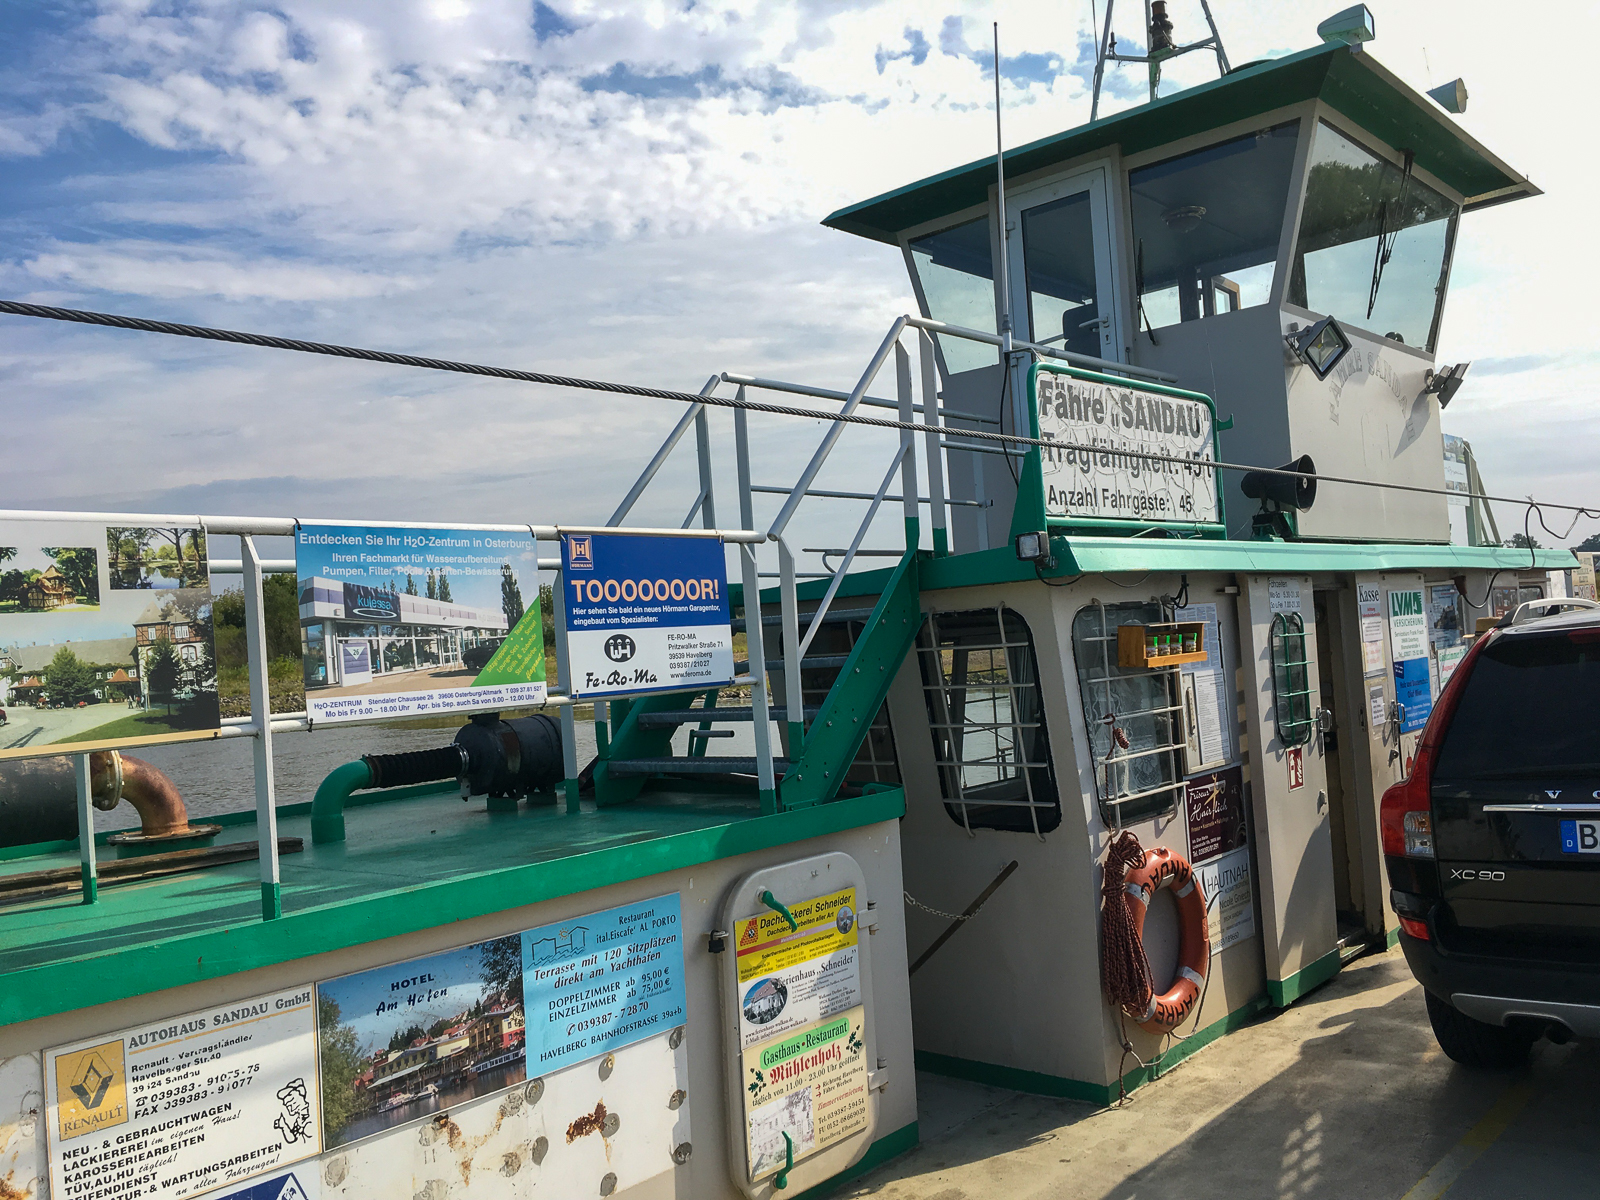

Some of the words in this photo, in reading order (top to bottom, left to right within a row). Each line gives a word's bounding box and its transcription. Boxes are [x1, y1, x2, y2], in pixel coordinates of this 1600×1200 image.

[1040, 380, 1105, 425] Fähre
[1048, 485, 1097, 508] Anzahl
[1102, 489, 1170, 515] Fahrgäste:
[1180, 494, 1192, 513] 45
[300, 533, 362, 545] Entdecken
[366, 534, 383, 546] Sie
[386, 536, 401, 546] Ihr
[473, 538, 482, 547] in
[484, 538, 534, 550] Osterburg,
[576, 544, 585, 555] H
[332, 553, 358, 563] Ihren
[360, 554, 409, 563] Fachmarkt
[411, 554, 424, 563] für
[426, 554, 510, 565] Wasseraufbereitung,
[322, 566, 366, 577] Pumpen,
[368, 566, 395, 577] Filter,
[398, 566, 424, 576] Pools
[434, 567, 519, 578] Garten-Bewässerung
[571, 579, 719, 603] TOOOOOOOR!
[1359, 586, 1380, 603] Kasse
[358, 595, 392, 610] kulessa
[608, 606, 618, 614] Sie
[690, 604, 720, 613] Garagentor,
[1391, 592, 1413, 617] LVM
[574, 618, 605, 626] eingebaut
[621, 616, 658, 624] Spezialisten:
[1394, 618, 1424, 628] VERSICHERUNG
[486, 644, 509, 673] Sitzgruppen
[670, 670, 712, 678] www.feroma.de
[368, 698, 397, 706] Stendaler
[438, 692, 454, 700] 39606
[454, 689, 502, 698] Osterburg/Altmark
[1567, 840, 1573, 848] D
[1208, 863, 1248, 894] HAUTNAH
[816, 894, 852, 913] Schneider
[619, 909, 655, 925] Restaurant
[640, 922, 649, 932] AL
[652, 914, 677, 929] PORTO
[816, 914, 826, 923] aller
[534, 962, 576, 981] Terrasse
[582, 954, 598, 968] mit
[604, 948, 622, 961] 120
[627, 934, 677, 956] Sitzplätzen
[554, 974, 583, 989] direkt
[590, 968, 604, 979] am
[610, 951, 661, 973] Yachthafen
[391, 974, 435, 991] HOTEL
[549, 982, 621, 1011] DOPPELZIMMER
[626, 977, 636, 987] ab
[642, 969, 663, 983] 95,00
[376, 1001, 398, 1016] Am
[408, 988, 448, 1006] Hafen
[550, 994, 617, 1022] EINZELZIMMER
[626, 989, 637, 999] ab
[642, 980, 664, 994] 75,00
[129, 1019, 206, 1049] AUTOHAUS
[213, 1002, 269, 1026] SANDAU
[275, 992, 311, 1010] GmbH
[578, 1012, 612, 1032] 039387
[540, 1039, 587, 1062] HAVELBERG
[591, 1014, 659, 1044] BAHNHOFSTRASSE
[662, 1006, 682, 1021] 39a+b
[764, 1041, 801, 1067] Gasthaus
[806, 1021, 848, 1048] Restaurant
[132, 1057, 169, 1073] Renault
[132, 1062, 191, 1083] Havelberger
[770, 1042, 841, 1085] Mühlenholz
[166, 1070, 200, 1085] Sandau
[752, 1092, 772, 1107] täglich
[774, 1088, 784, 1096] von
[786, 1078, 802, 1092] 11.00
[809, 1068, 826, 1082] 23.00
[827, 1064, 837, 1076] Uhr
[839, 1054, 860, 1070] geöffnet
[822, 1074, 841, 1087] Richtung
[842, 1065, 864, 1078] Havelberg
[823, 1086, 835, 1095] Fähre
[836, 1078, 852, 1088] Werben
[151, 1083, 195, 1103] 039383
[818, 1085, 864, 1111] Zimmervermietung
[64, 1107, 124, 1133] RENAULT
[134, 1106, 158, 1119] FAX
[63, 1146, 90, 1161] NEU
[102, 1140, 111, 1149] &
[116, 1102, 232, 1145] GEBRAUCHTWAGEN
[64, 1141, 148, 1172] LACKIEREREI
[152, 1137, 164, 1146] im
[170, 1124, 205, 1140] eigenen
[212, 1110, 241, 1127] Haus!
[65, 1134, 205, 1184] KAROSSERIEARBEITEN
[150, 1184, 158, 1193] &
[162, 1142, 282, 1189] WARTUNGSARBEITEN
[65, 1168, 134, 1196] TÜV,AU,HU
[138, 1153, 178, 1173] täglich!
[176, 1188, 187, 1196] an
[194, 1178, 217, 1191] allen
[225, 1154, 280, 1181] Fahrzeugen!
